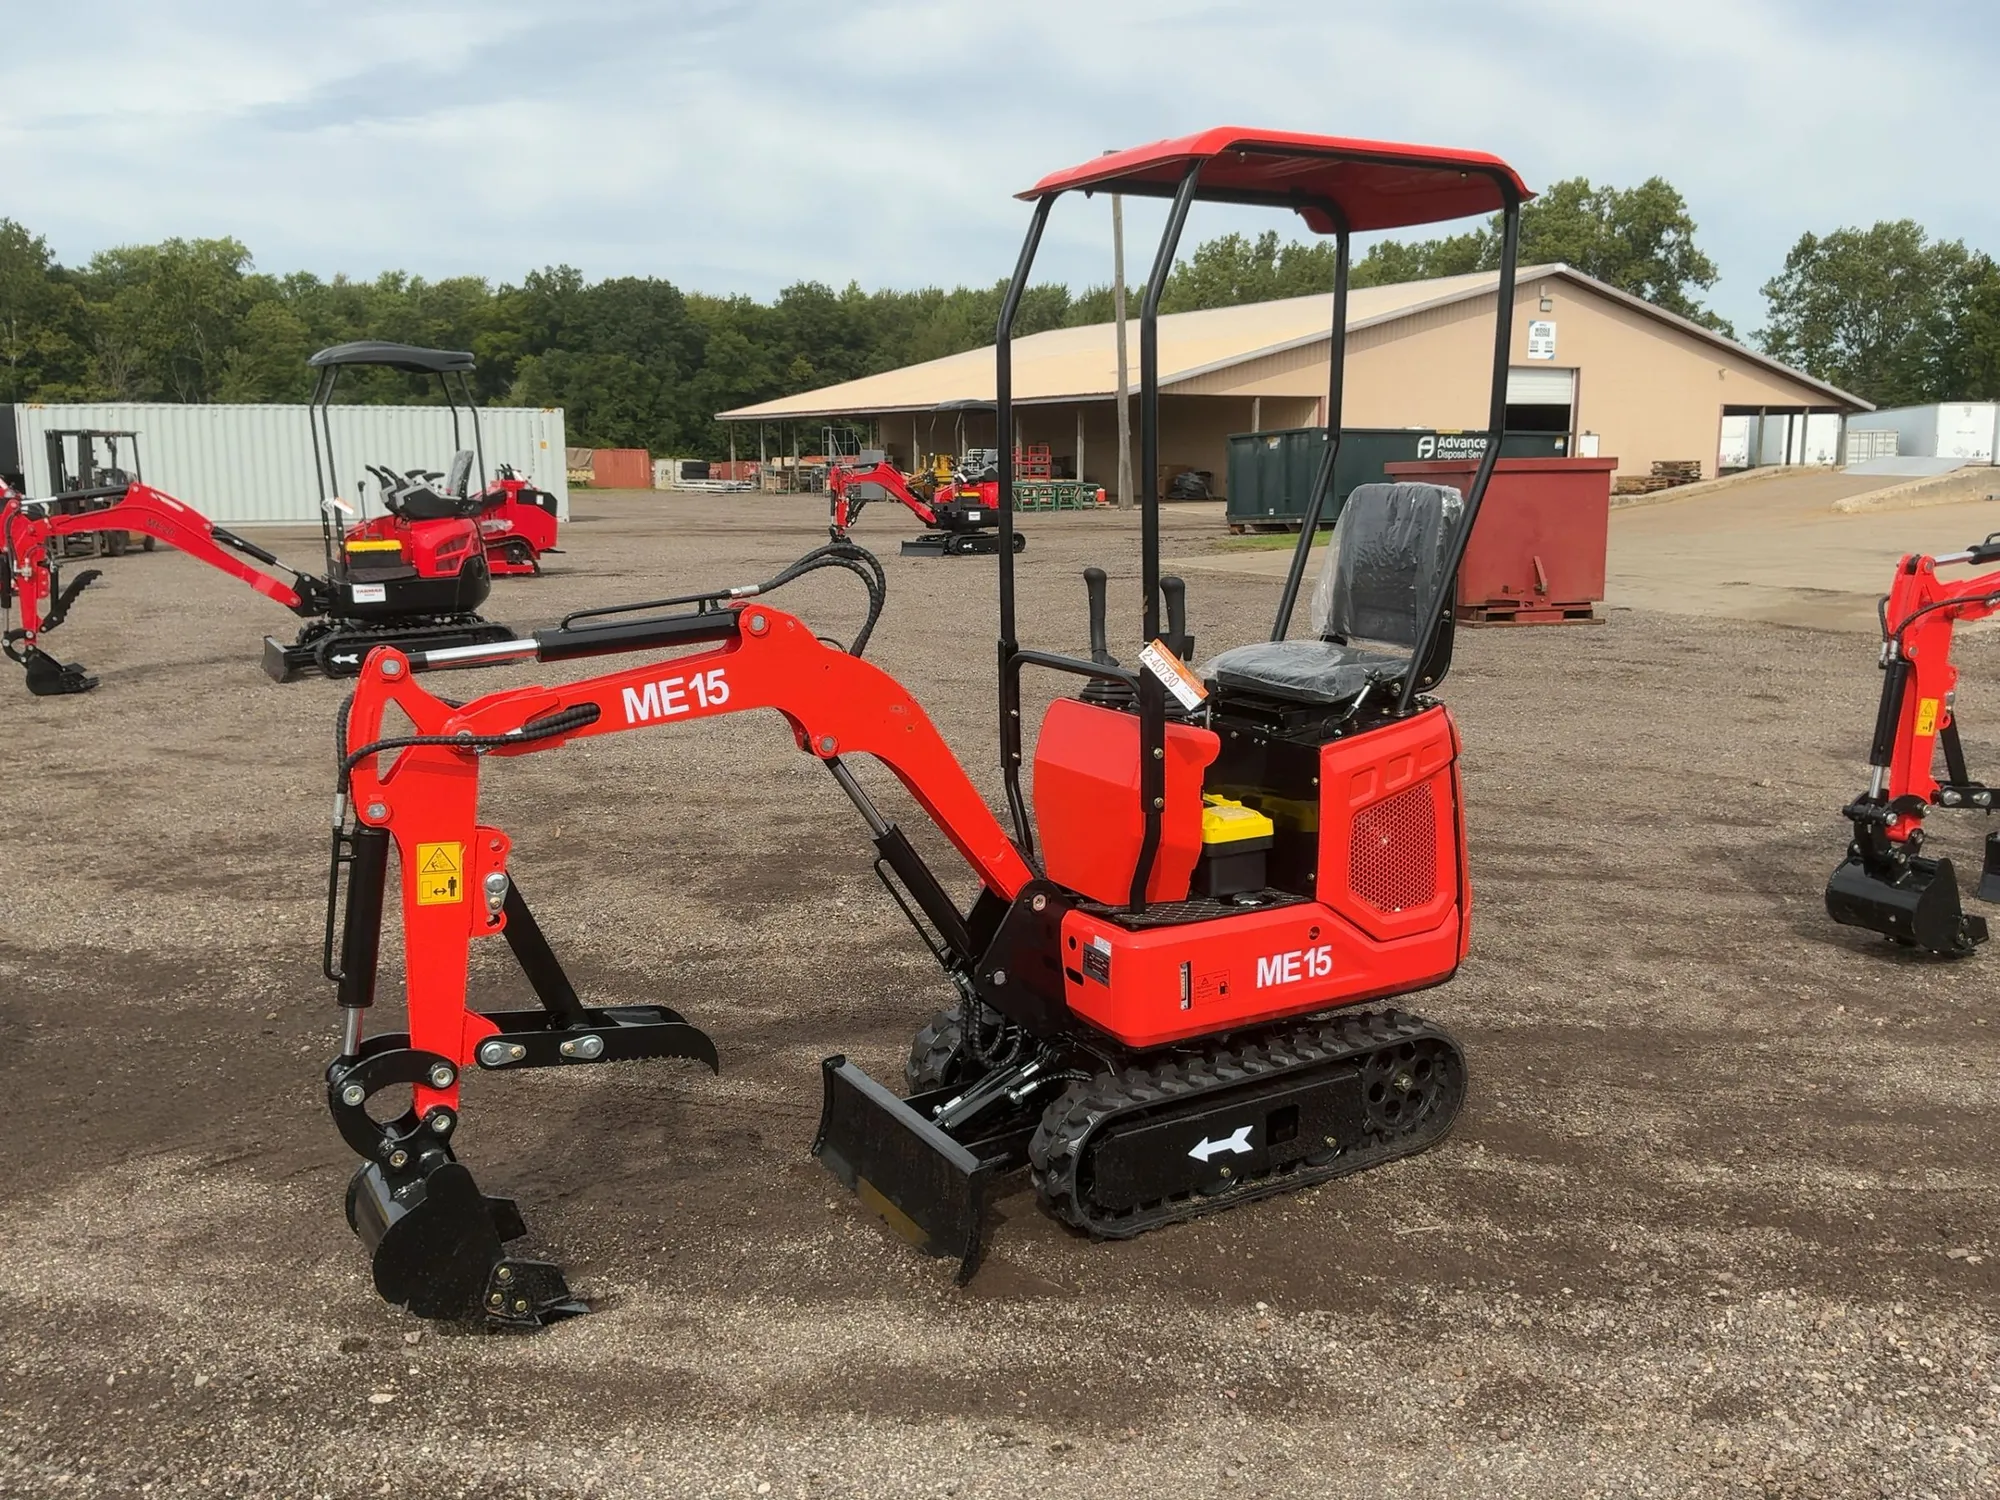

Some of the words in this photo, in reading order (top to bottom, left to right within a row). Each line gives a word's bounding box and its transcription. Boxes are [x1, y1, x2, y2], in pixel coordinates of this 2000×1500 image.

[1437, 436, 1487, 449] Advance
[1437, 450, 1467, 460] Disposal
[1468, 450, 1485, 459] Serv
[1142, 649, 1180, 688] 2-40730
[622, 669, 729, 723] ME15
[1256, 945, 1331, 988] ME15
